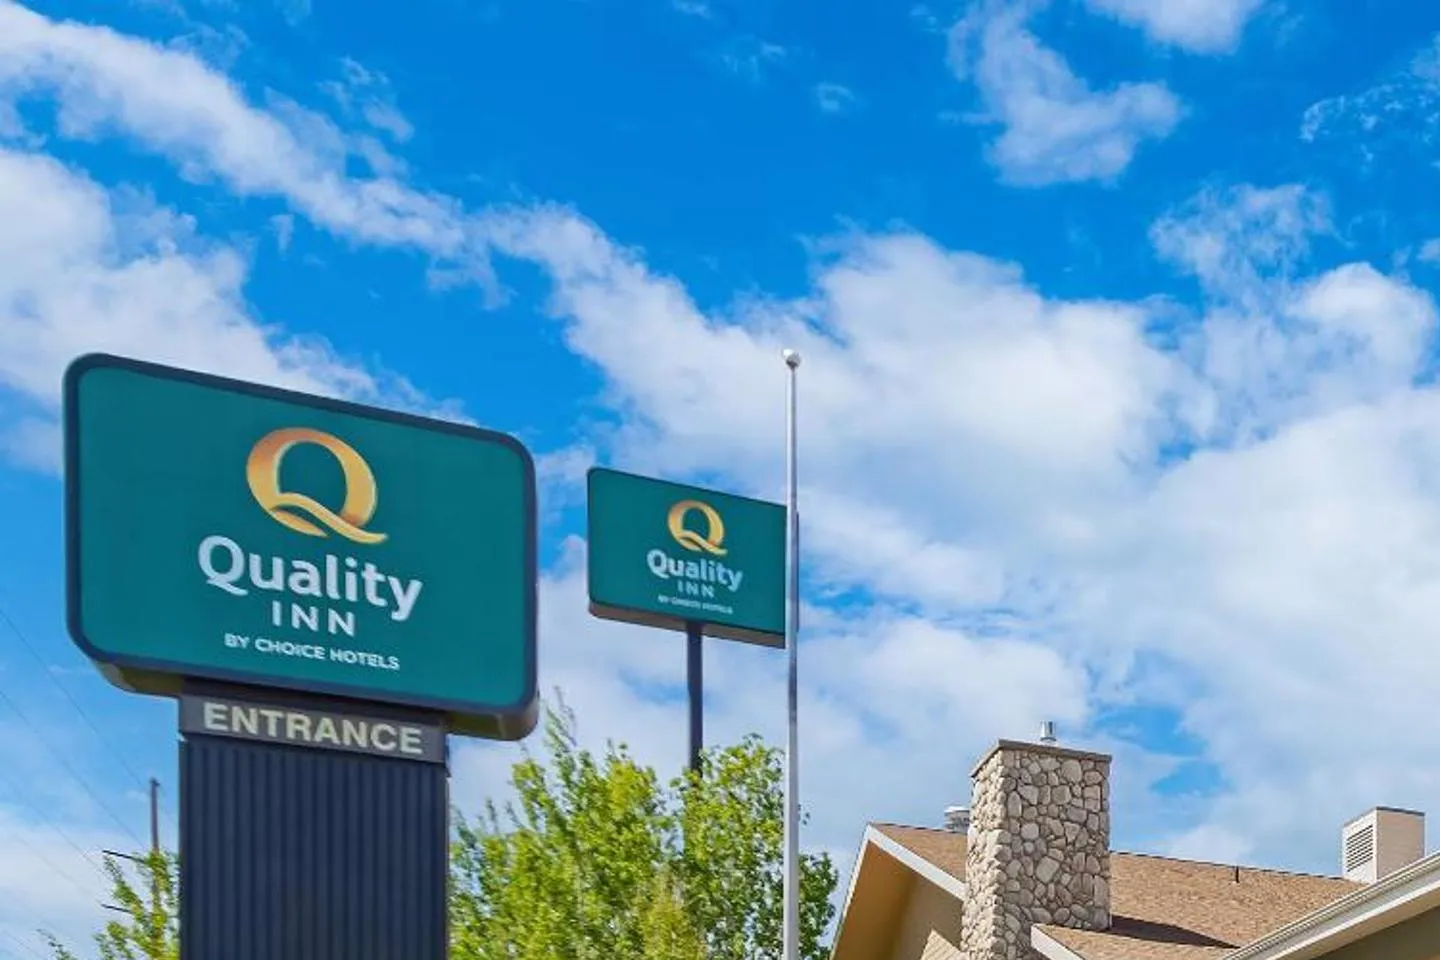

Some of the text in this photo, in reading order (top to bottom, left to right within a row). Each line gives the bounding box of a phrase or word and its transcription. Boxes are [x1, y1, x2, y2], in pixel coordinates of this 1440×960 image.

[198, 535, 423, 622] Quality
[646, 549, 743, 592] Quality
[677, 580, 715, 598] INN
[271, 601, 356, 637] INN
[224, 633, 401, 671] BY CHOICE HOTELS
[203, 702, 424, 754] ENTRANCE
